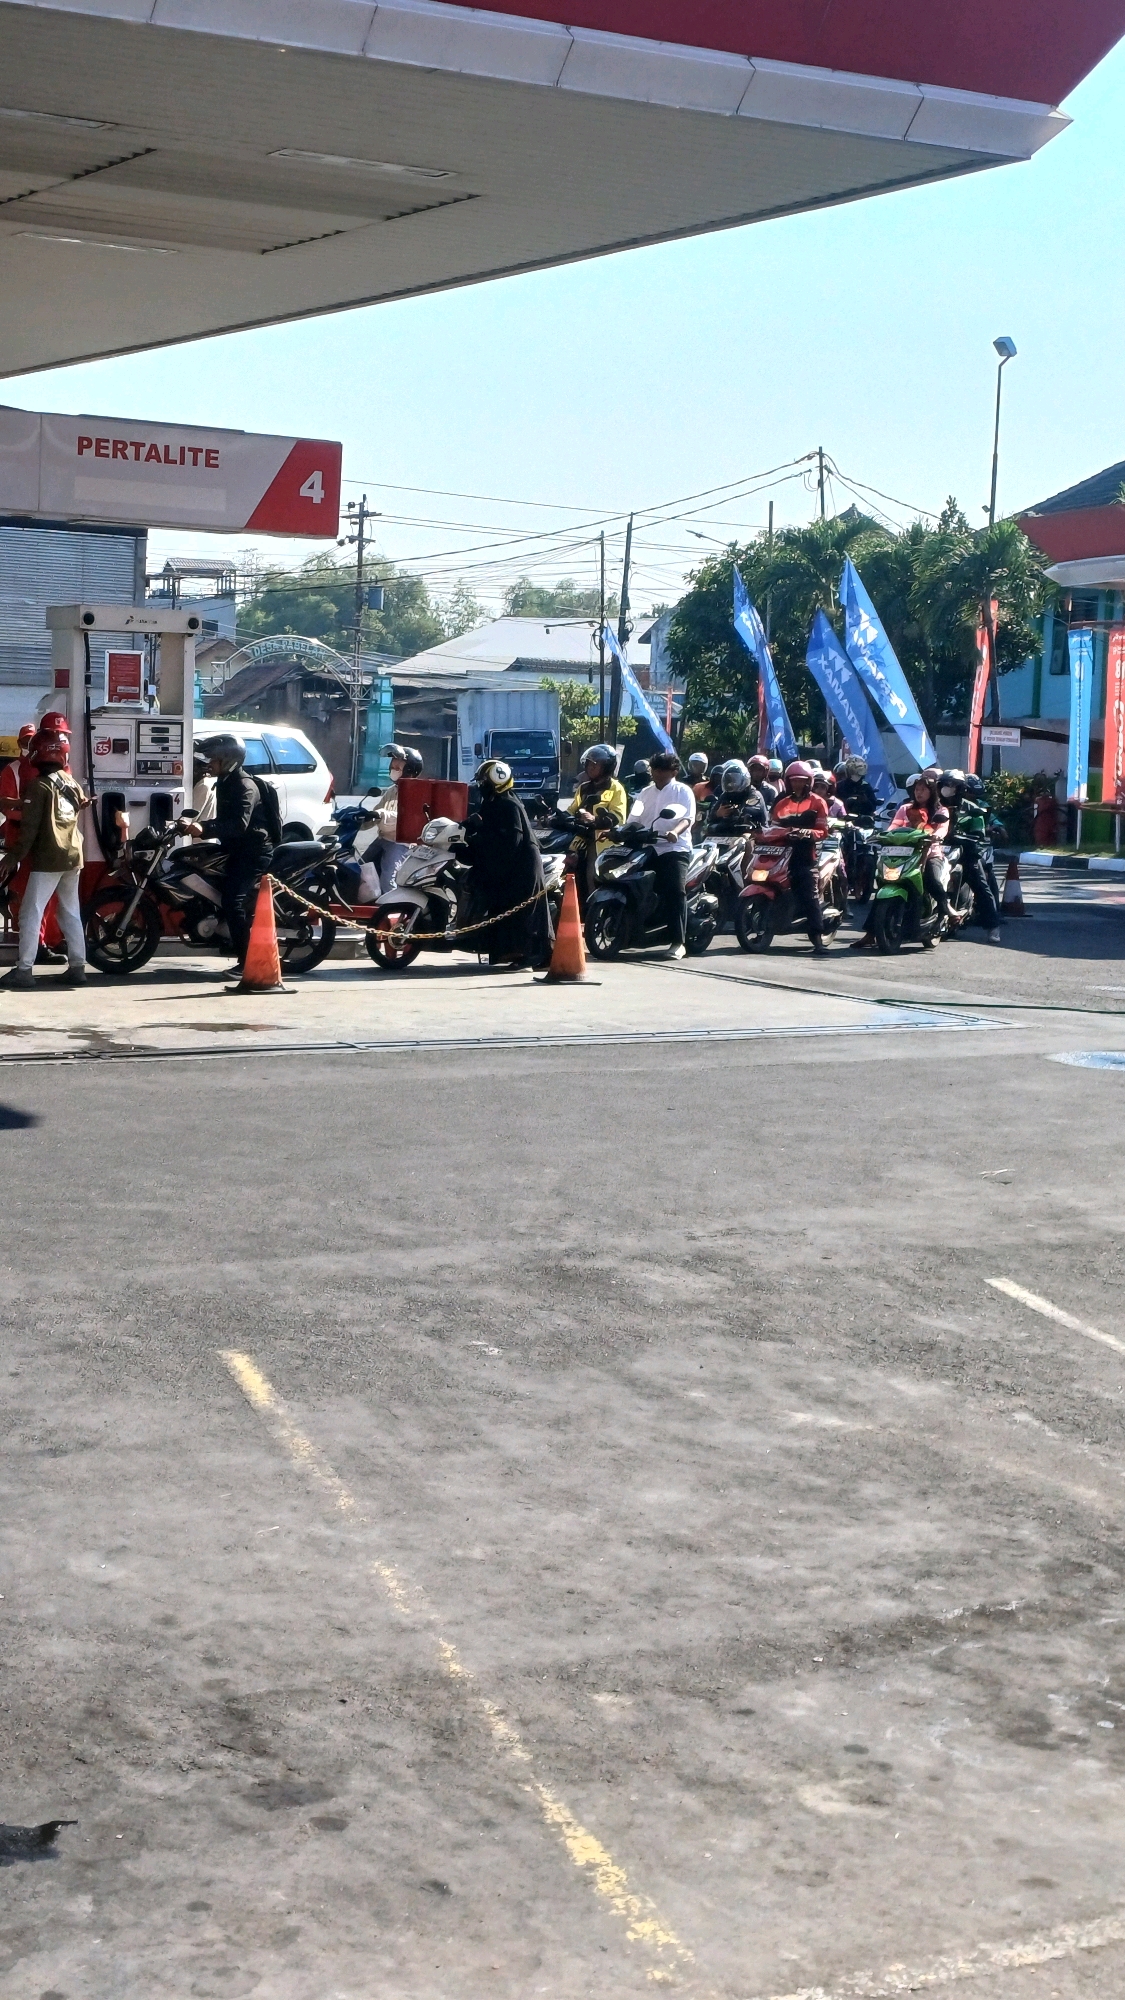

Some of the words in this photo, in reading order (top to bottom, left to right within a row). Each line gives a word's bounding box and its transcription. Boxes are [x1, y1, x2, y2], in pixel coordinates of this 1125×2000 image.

[77, 436, 220, 469] PERTALITE
[300, 470, 325, 504] 4
[253, 641, 282, 657] DESA
[173, 793, 180, 805] 4
